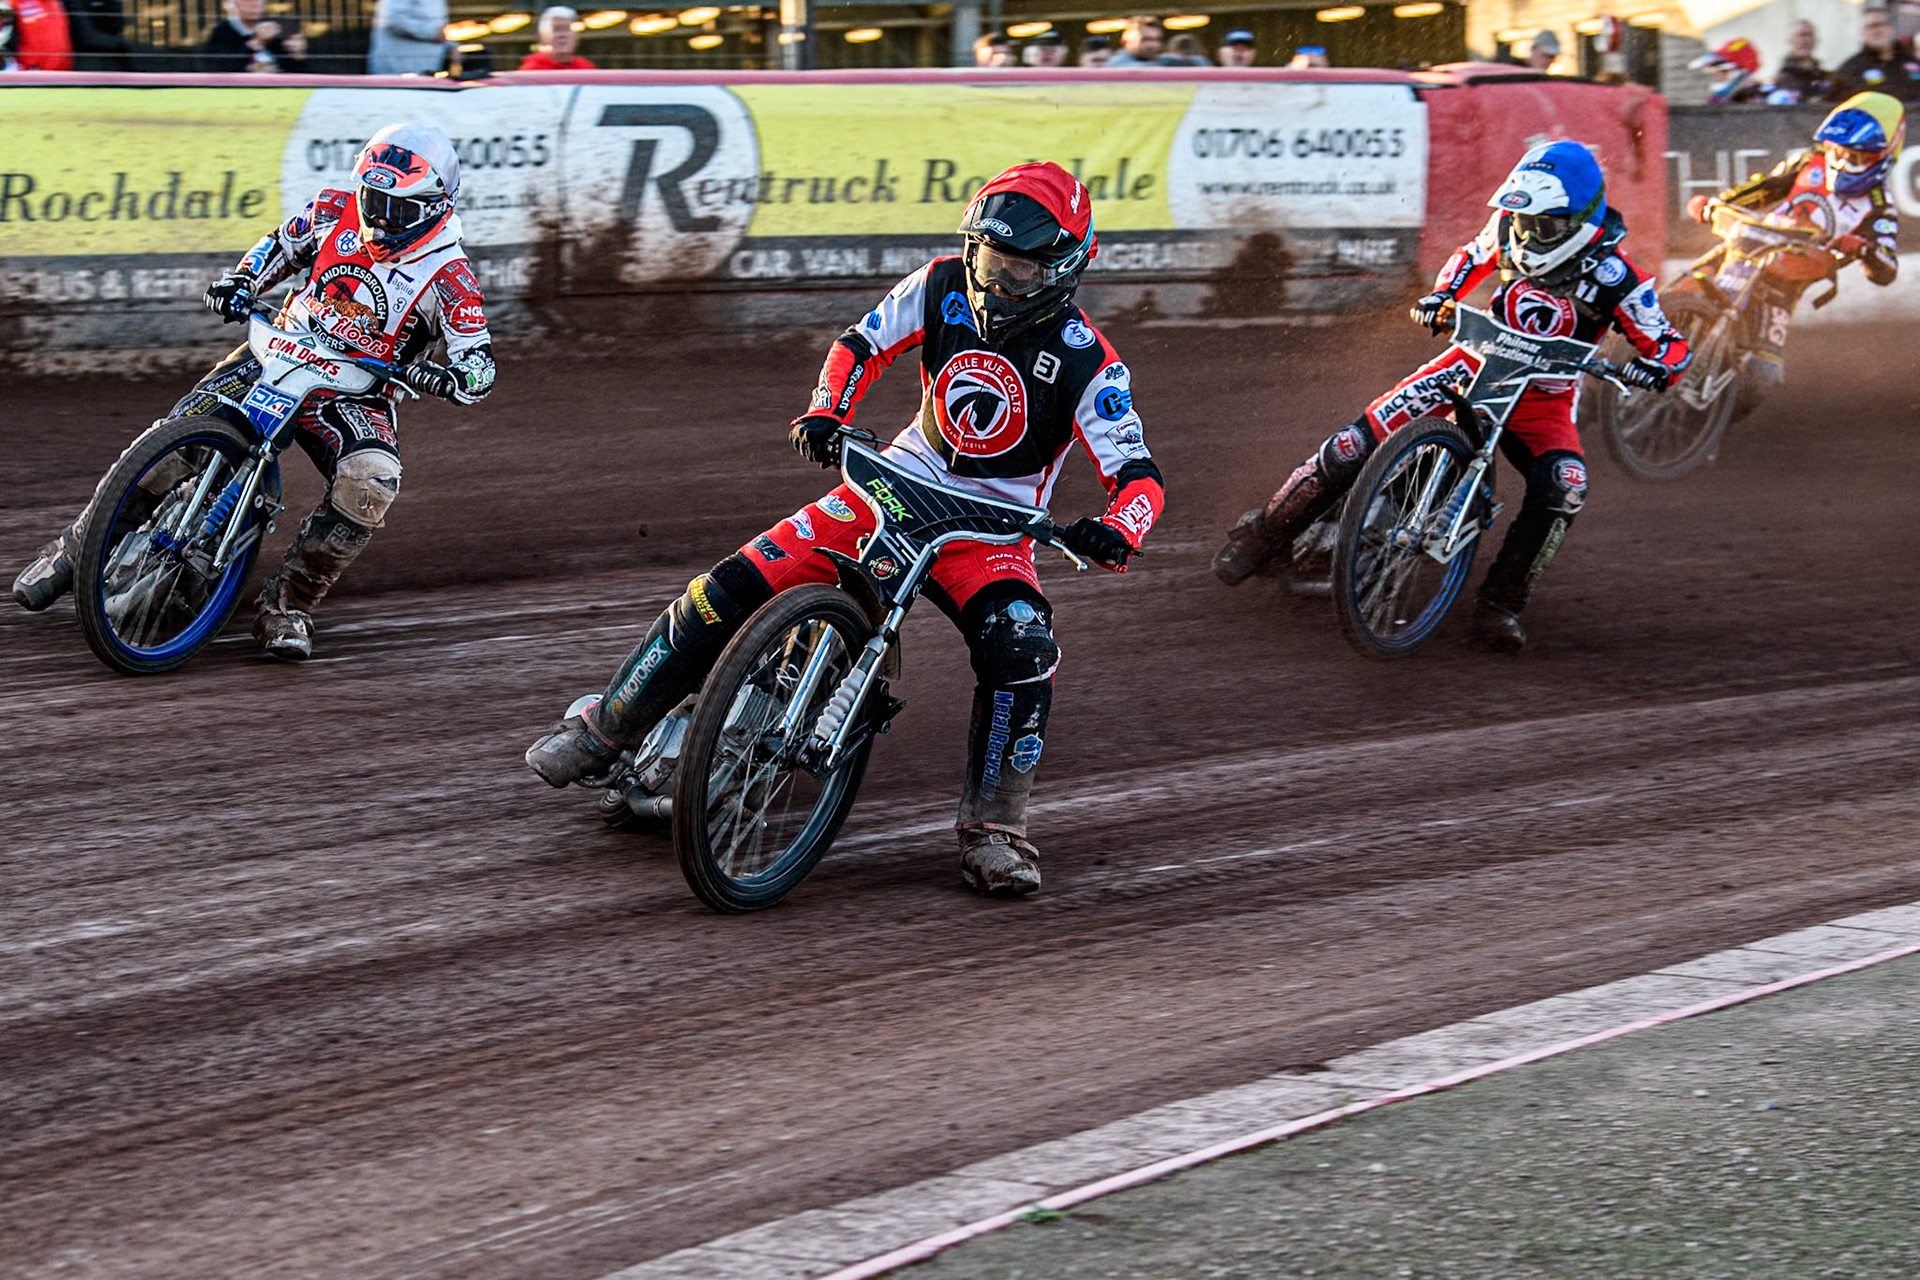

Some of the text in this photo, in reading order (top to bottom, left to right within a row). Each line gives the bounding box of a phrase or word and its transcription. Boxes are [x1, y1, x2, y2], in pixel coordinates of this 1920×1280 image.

[1192, 128, 1406, 158] 01706 640055
[0, 171, 266, 222] Rochdale
[320, 264, 388, 320] MIDDLESBROUGH
[391, 278, 415, 297] agilia
[392, 296, 408, 314] 3
[312, 323, 346, 351] TIGERS
[329, 315, 391, 357] floors
[1069, 325, 1088, 343] ATPI
[1496, 332, 1542, 354] Philmar
[268, 337, 298, 356] CHM
[296, 347, 341, 376] Doors
[1036, 354, 1056, 379] 3
[206, 375, 238, 392] Racing
[946, 357, 1022, 414] BELLE VUE COLTS
[1378, 389, 1414, 422] JACK
[1407, 392, 1448, 418] & SO
[1563, 469, 1586, 482] STS
[866, 478, 914, 522] FORK
[868, 559, 901, 577] PENRITE
[618, 642, 668, 704] MOTOREX
[991, 690, 1014, 733] Metal
